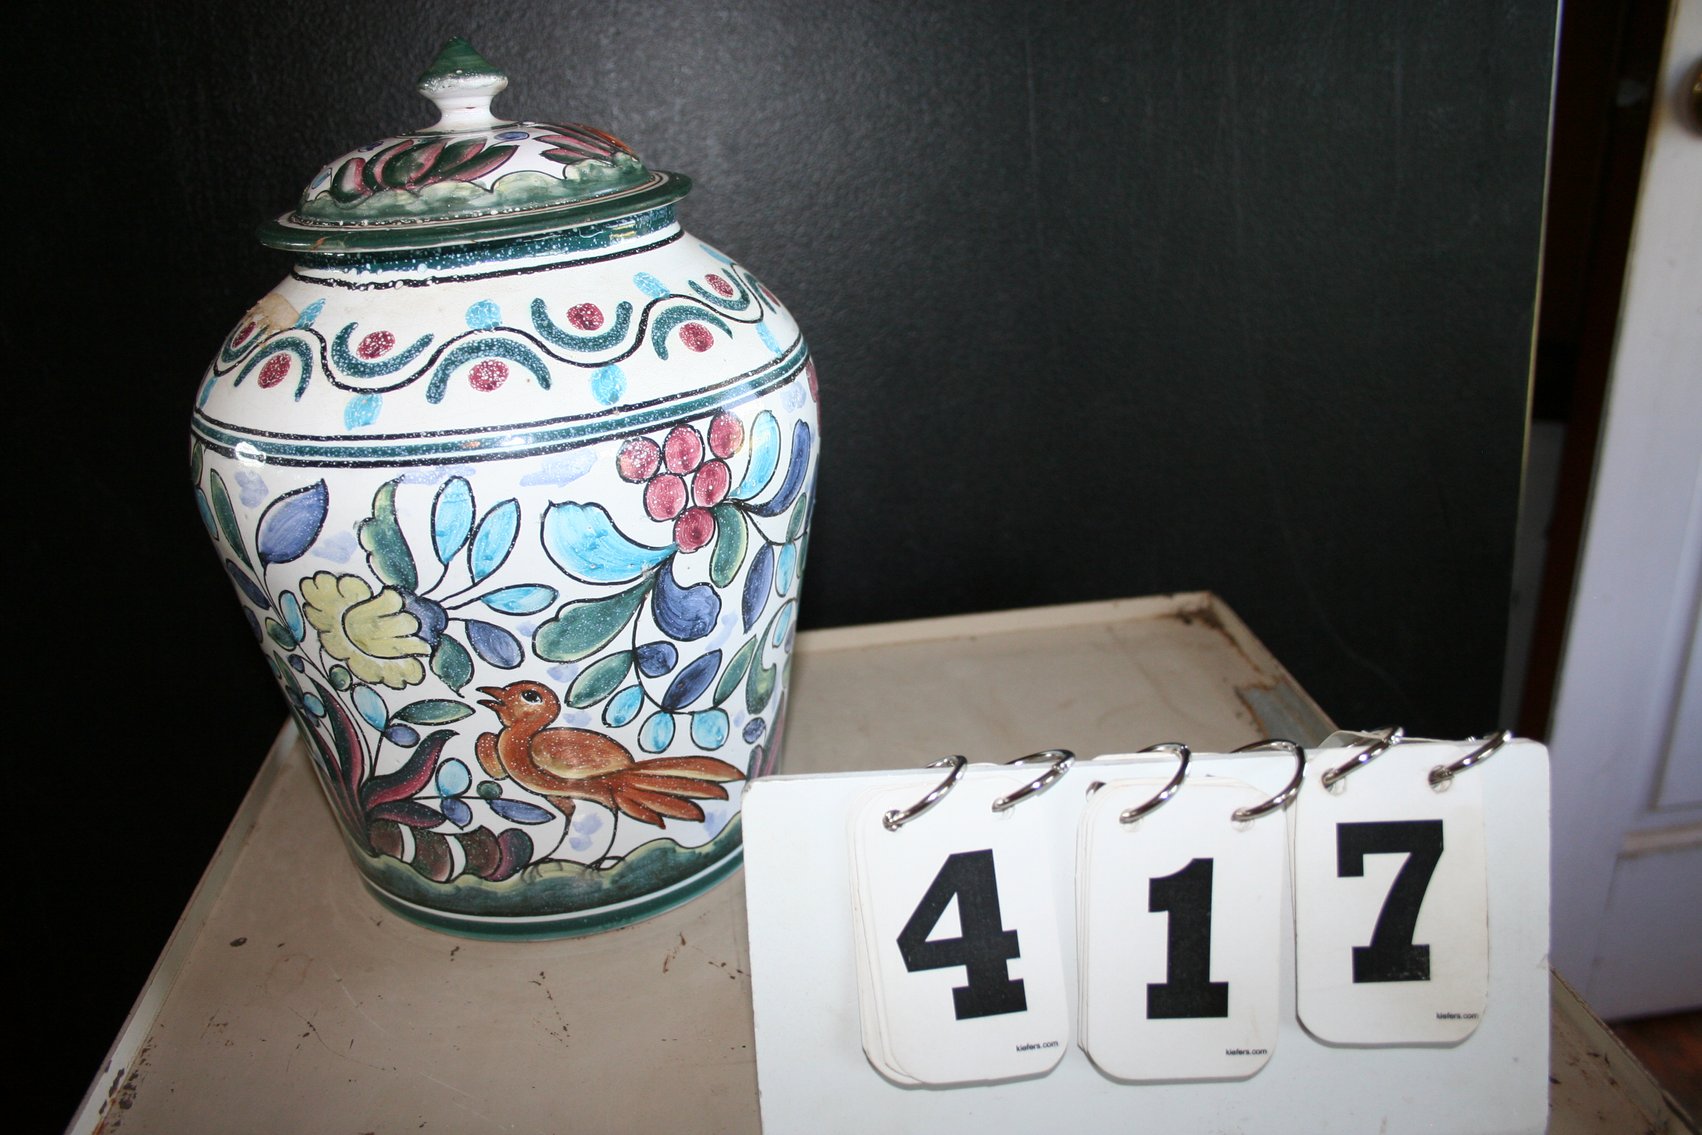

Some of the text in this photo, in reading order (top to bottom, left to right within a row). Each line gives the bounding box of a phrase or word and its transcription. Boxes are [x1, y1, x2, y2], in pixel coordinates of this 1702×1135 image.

[896, 819, 1445, 1021] 4 1 7
[1436, 1012, 1479, 1020] kiefers.com
[1016, 1041, 1059, 1052] kiefers.com
[1225, 1048, 1268, 1056] kiefers.com
